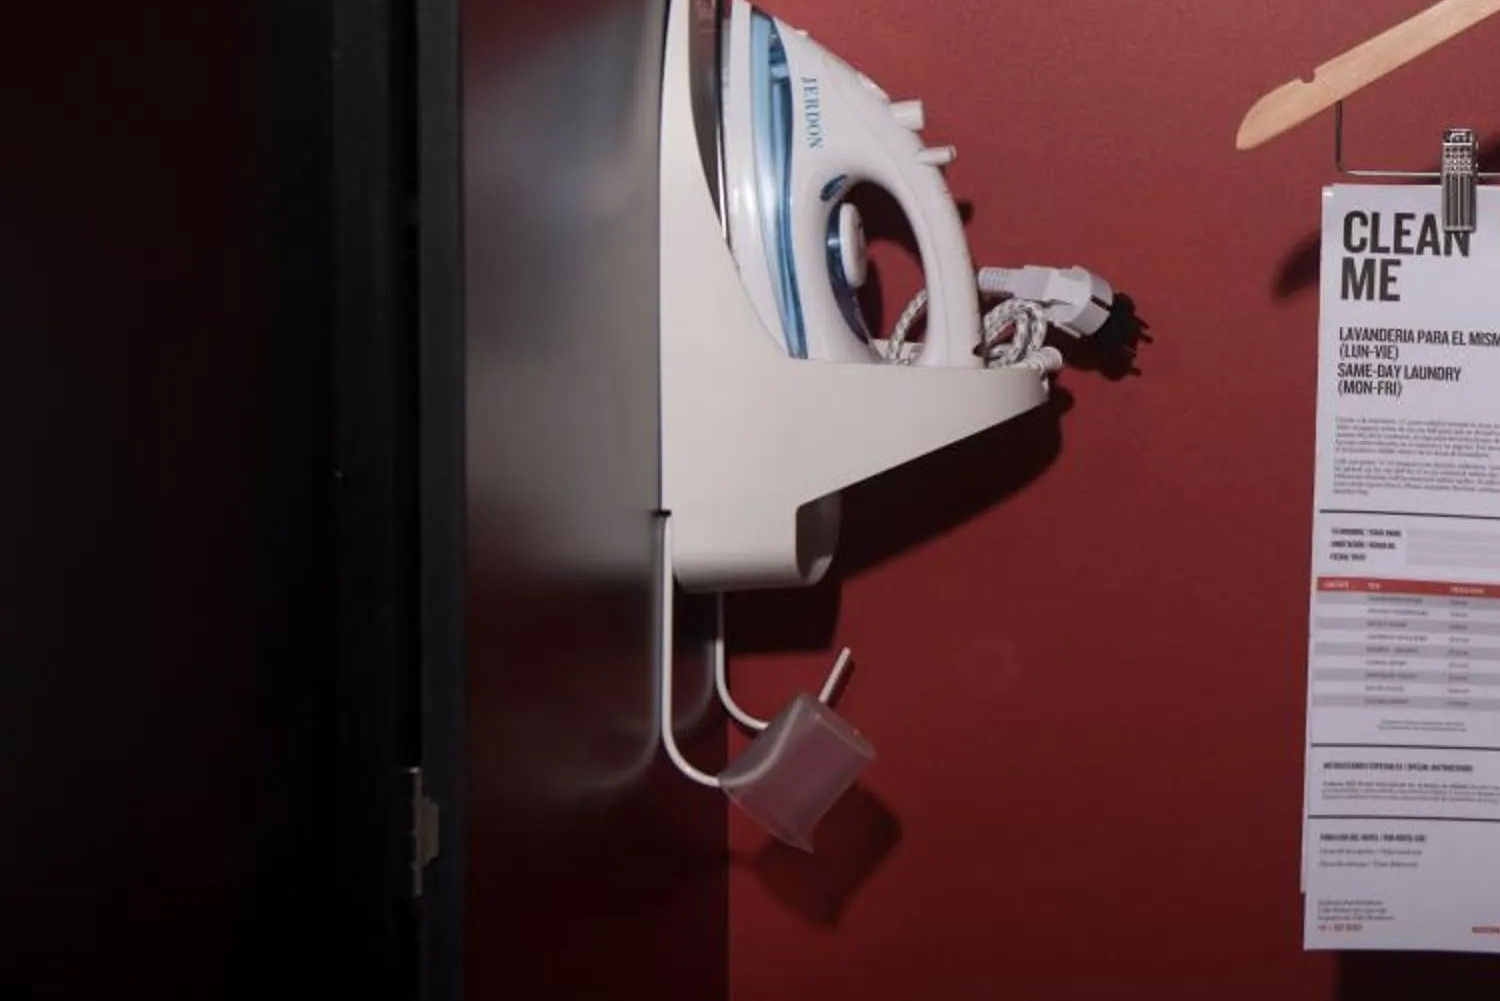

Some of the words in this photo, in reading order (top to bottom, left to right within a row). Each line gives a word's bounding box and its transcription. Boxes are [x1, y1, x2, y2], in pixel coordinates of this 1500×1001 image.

[799, 76, 824, 149] JERDON
[1340, 257, 1402, 302] ME
[1338, 326, 1416, 344] LAVANDERIA
[1417, 330, 1450, 345] PARA
[1451, 331, 1466, 346] EL
[1339, 343, 1399, 360] (LUN-VIE)
[1337, 362, 1401, 379] SAME-DAY
[1403, 365, 1462, 382] LAUNDRY
[1337, 380, 1403, 397] (MON-FRI)
